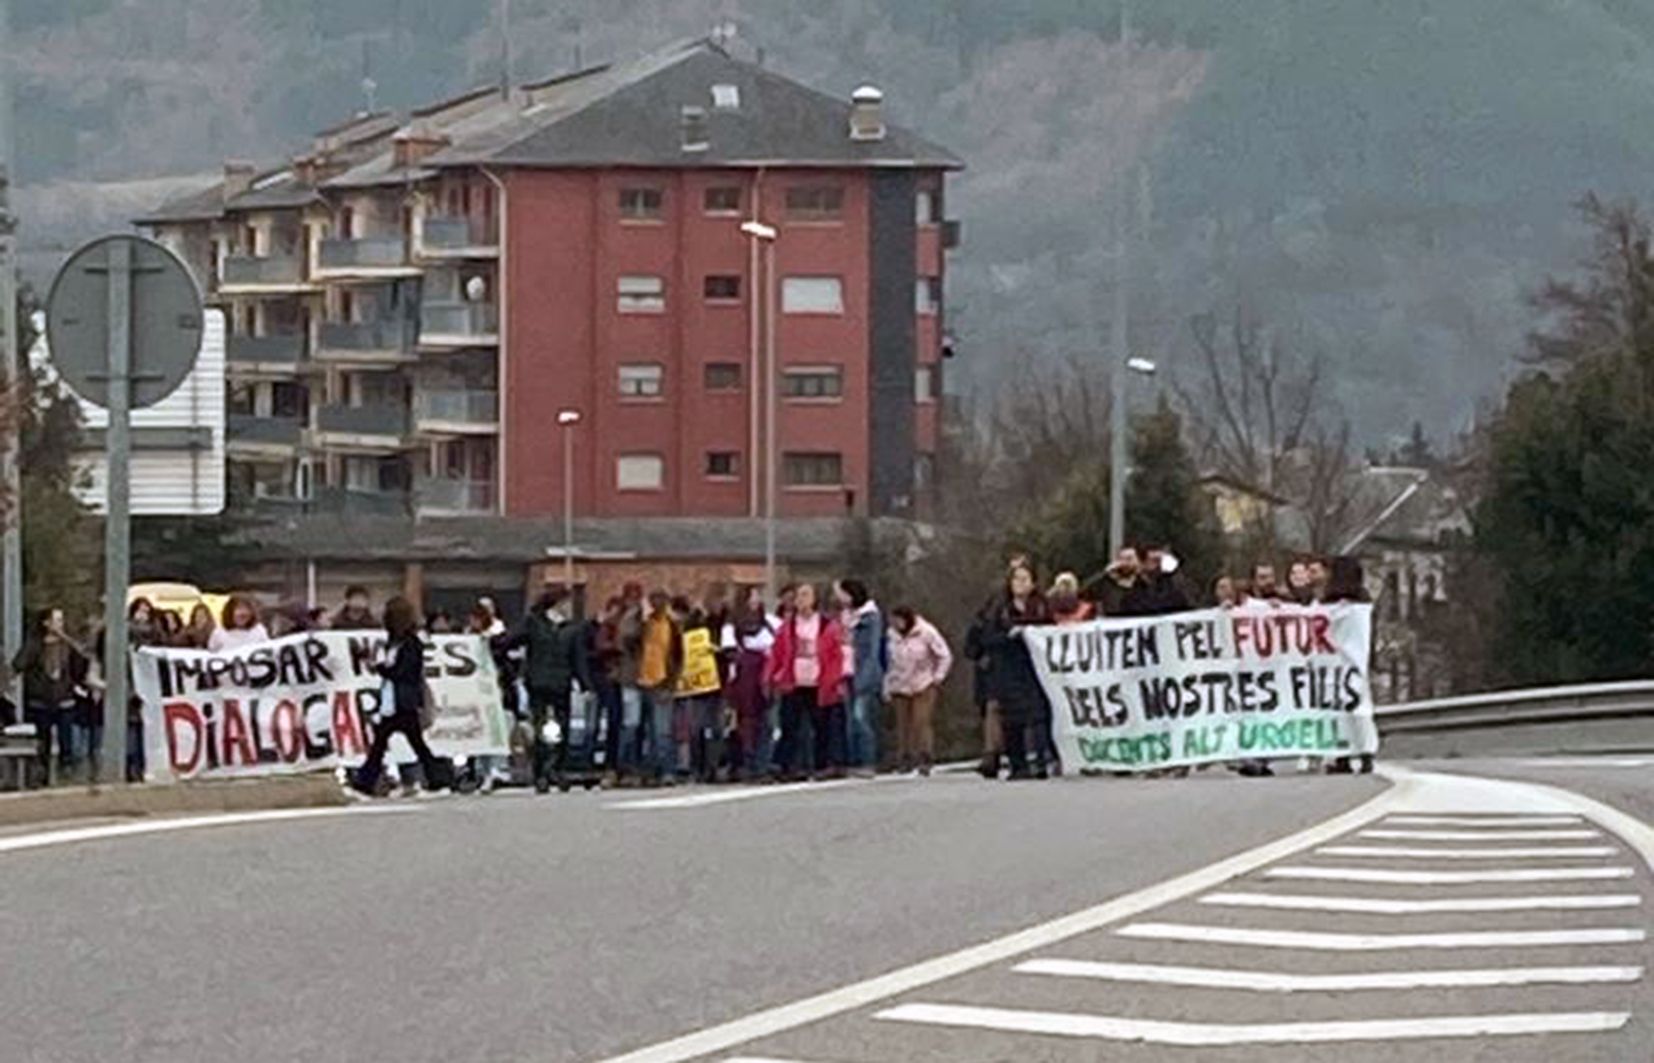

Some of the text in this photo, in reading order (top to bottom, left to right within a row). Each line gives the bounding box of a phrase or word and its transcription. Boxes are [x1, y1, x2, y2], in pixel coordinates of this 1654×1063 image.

[156, 636, 334, 698] IMPOSAR
[1045, 614, 1337, 673] LLUITEN PEL FUTUR
[1063, 682, 1129, 728] DELS
[1139, 670, 1280, 720] NOSTRES
[1183, 724, 1227, 756] ALT
[1238, 717, 1350, 750] URGELL
